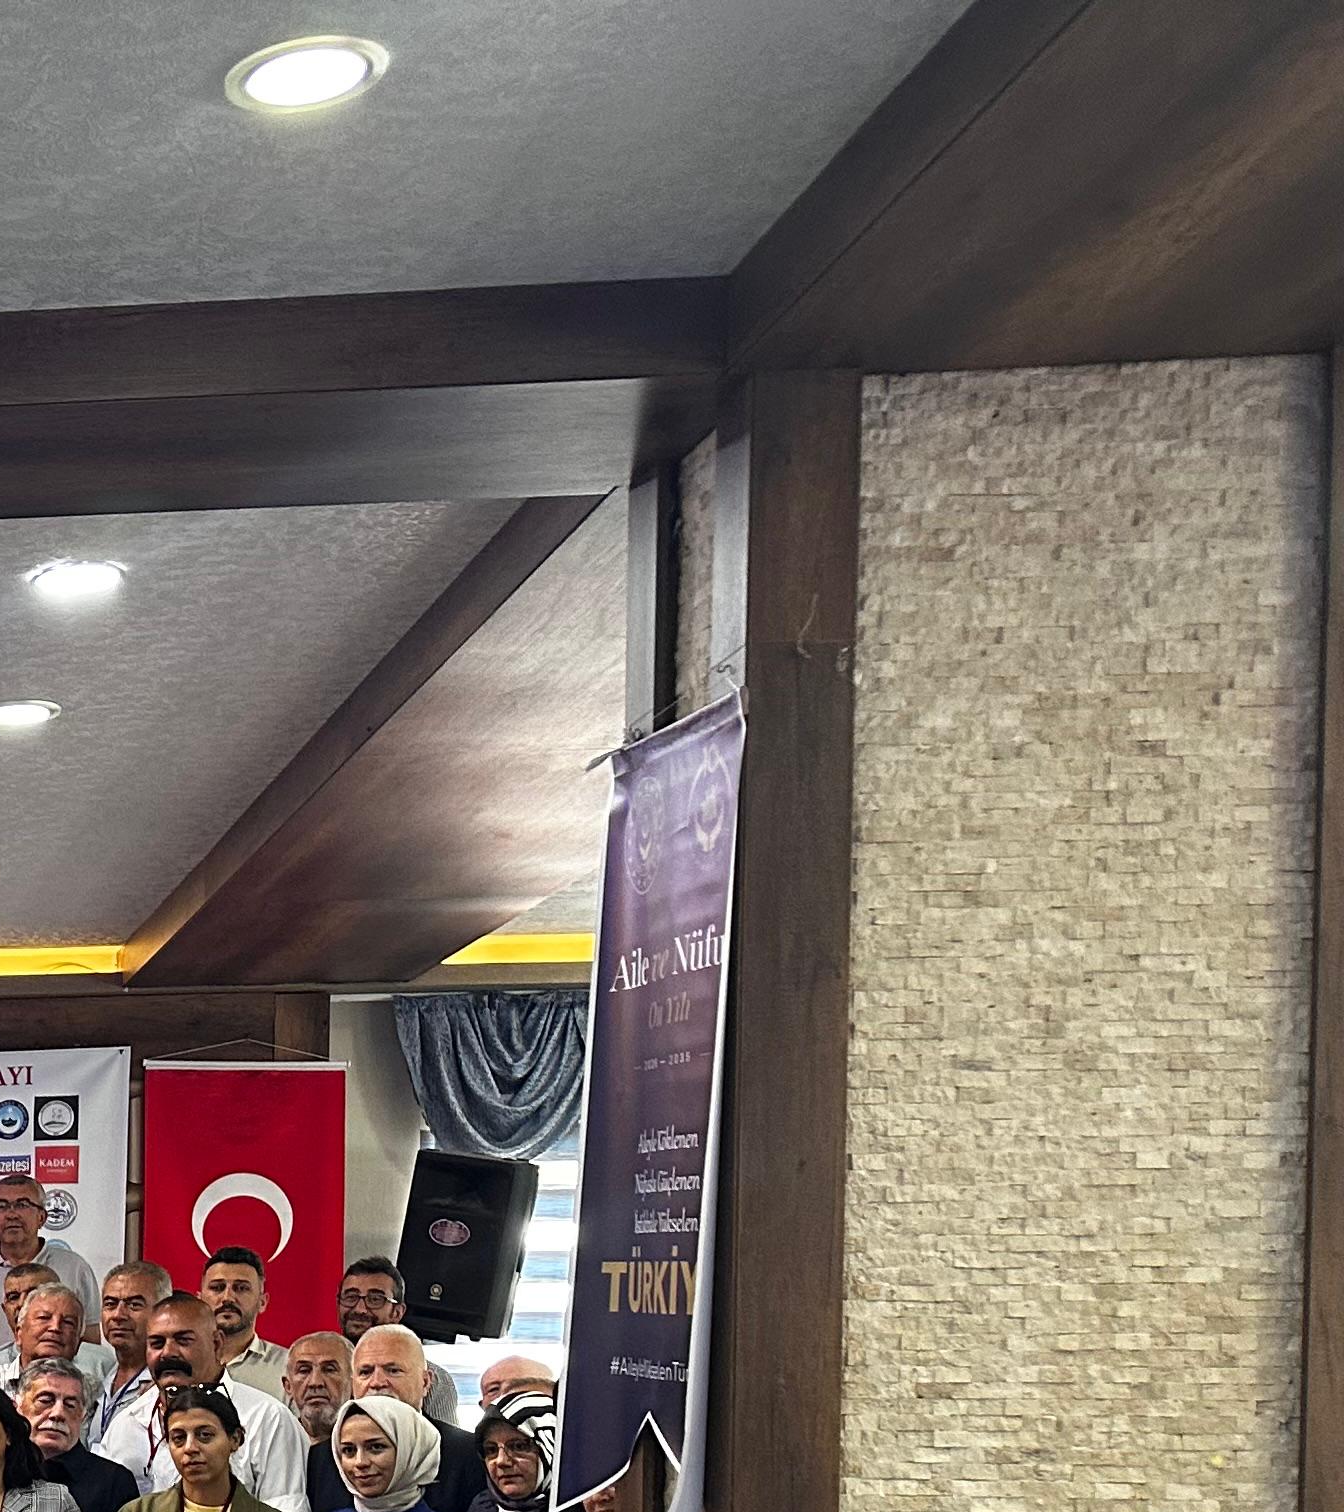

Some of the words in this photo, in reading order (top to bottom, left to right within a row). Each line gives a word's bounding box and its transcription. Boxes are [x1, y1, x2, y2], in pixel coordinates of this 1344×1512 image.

[609, 947, 649, 992] Aile
[672, 924, 724, 975] Nüfu
[39, 1159, 74, 1167] KADEM
[601, 1245, 697, 1315] TÜRKİY
